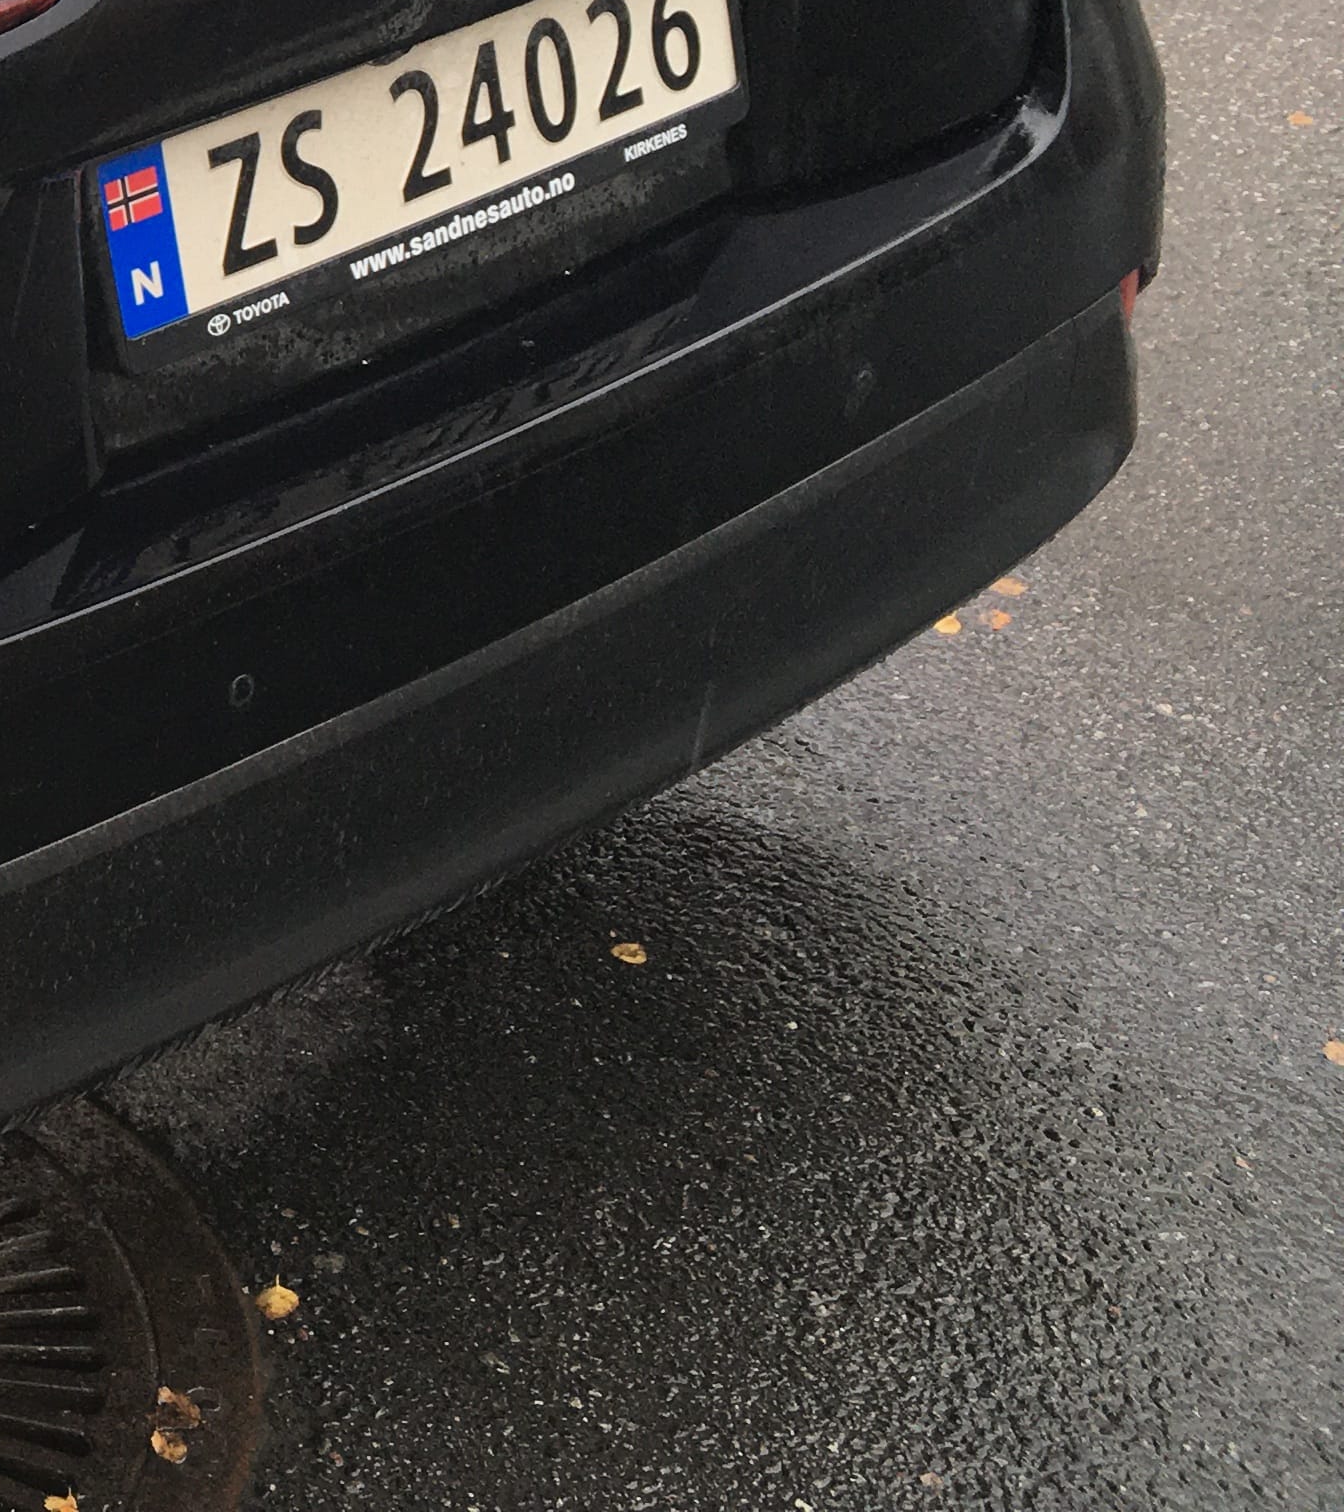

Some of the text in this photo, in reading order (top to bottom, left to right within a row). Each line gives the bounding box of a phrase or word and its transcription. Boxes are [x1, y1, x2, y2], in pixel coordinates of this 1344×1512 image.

[623, 122, 689, 162] KIRKENES
[207, 107, 340, 277] ZS
[349, 171, 577, 281] www.sandnesauto.no
[130, 259, 165, 306] N
[232, 292, 291, 326] TOYOTA
